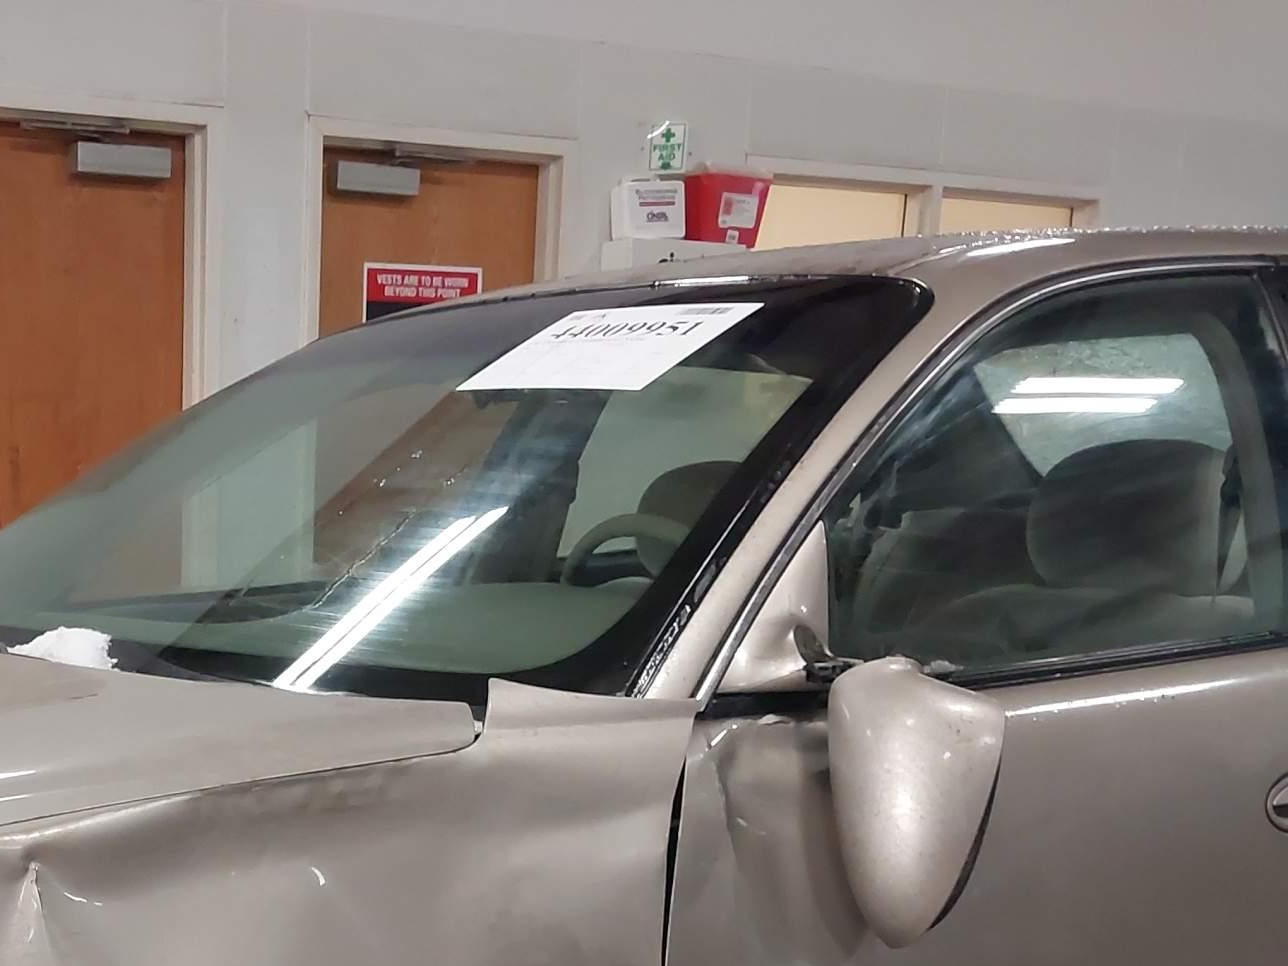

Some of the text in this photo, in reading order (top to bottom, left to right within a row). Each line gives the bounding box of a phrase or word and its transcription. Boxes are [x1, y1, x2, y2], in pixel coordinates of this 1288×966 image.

[653, 143, 682, 152] FIRST
[658, 152, 676, 161] AID
[376, 274, 402, 285] VESTS
[403, 275, 419, 286] ARE
[421, 275, 430, 287] TO
[432, 276, 443, 287] BE
[384, 285, 461, 298] BEYOND THIS POINT
[551, 320, 703, 339] 44009951
